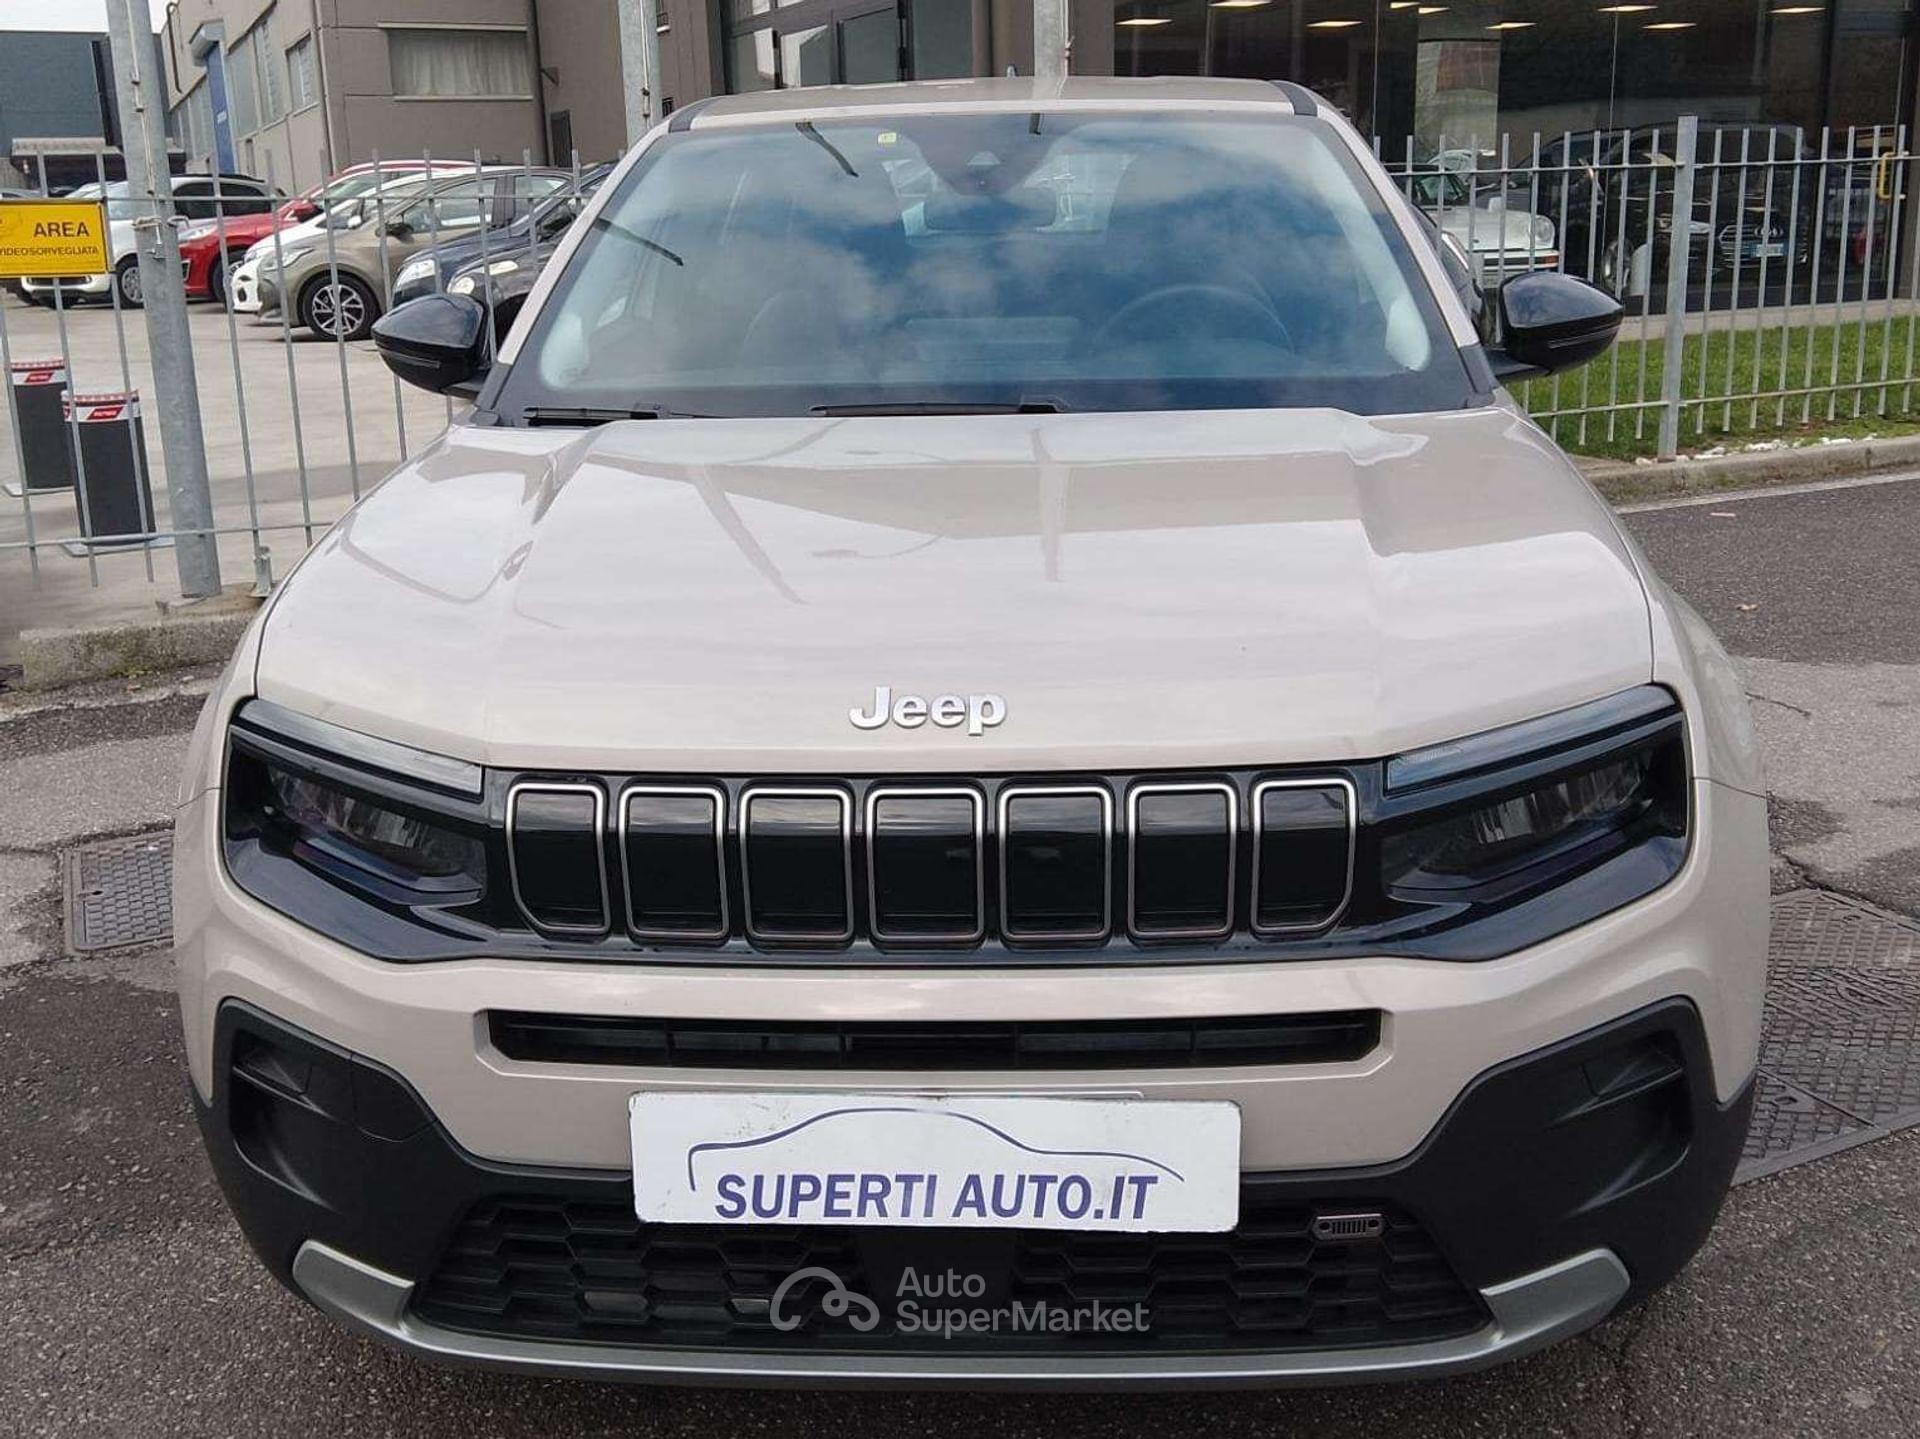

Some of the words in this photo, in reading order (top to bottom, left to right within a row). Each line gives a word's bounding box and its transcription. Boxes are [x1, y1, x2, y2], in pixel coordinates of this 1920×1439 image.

[33, 222, 89, 237] AREA
[849, 685, 1007, 736] Jeep
[715, 1174, 938, 1219] SUPERTI
[951, 1174, 1158, 1220] AUTO.IT
